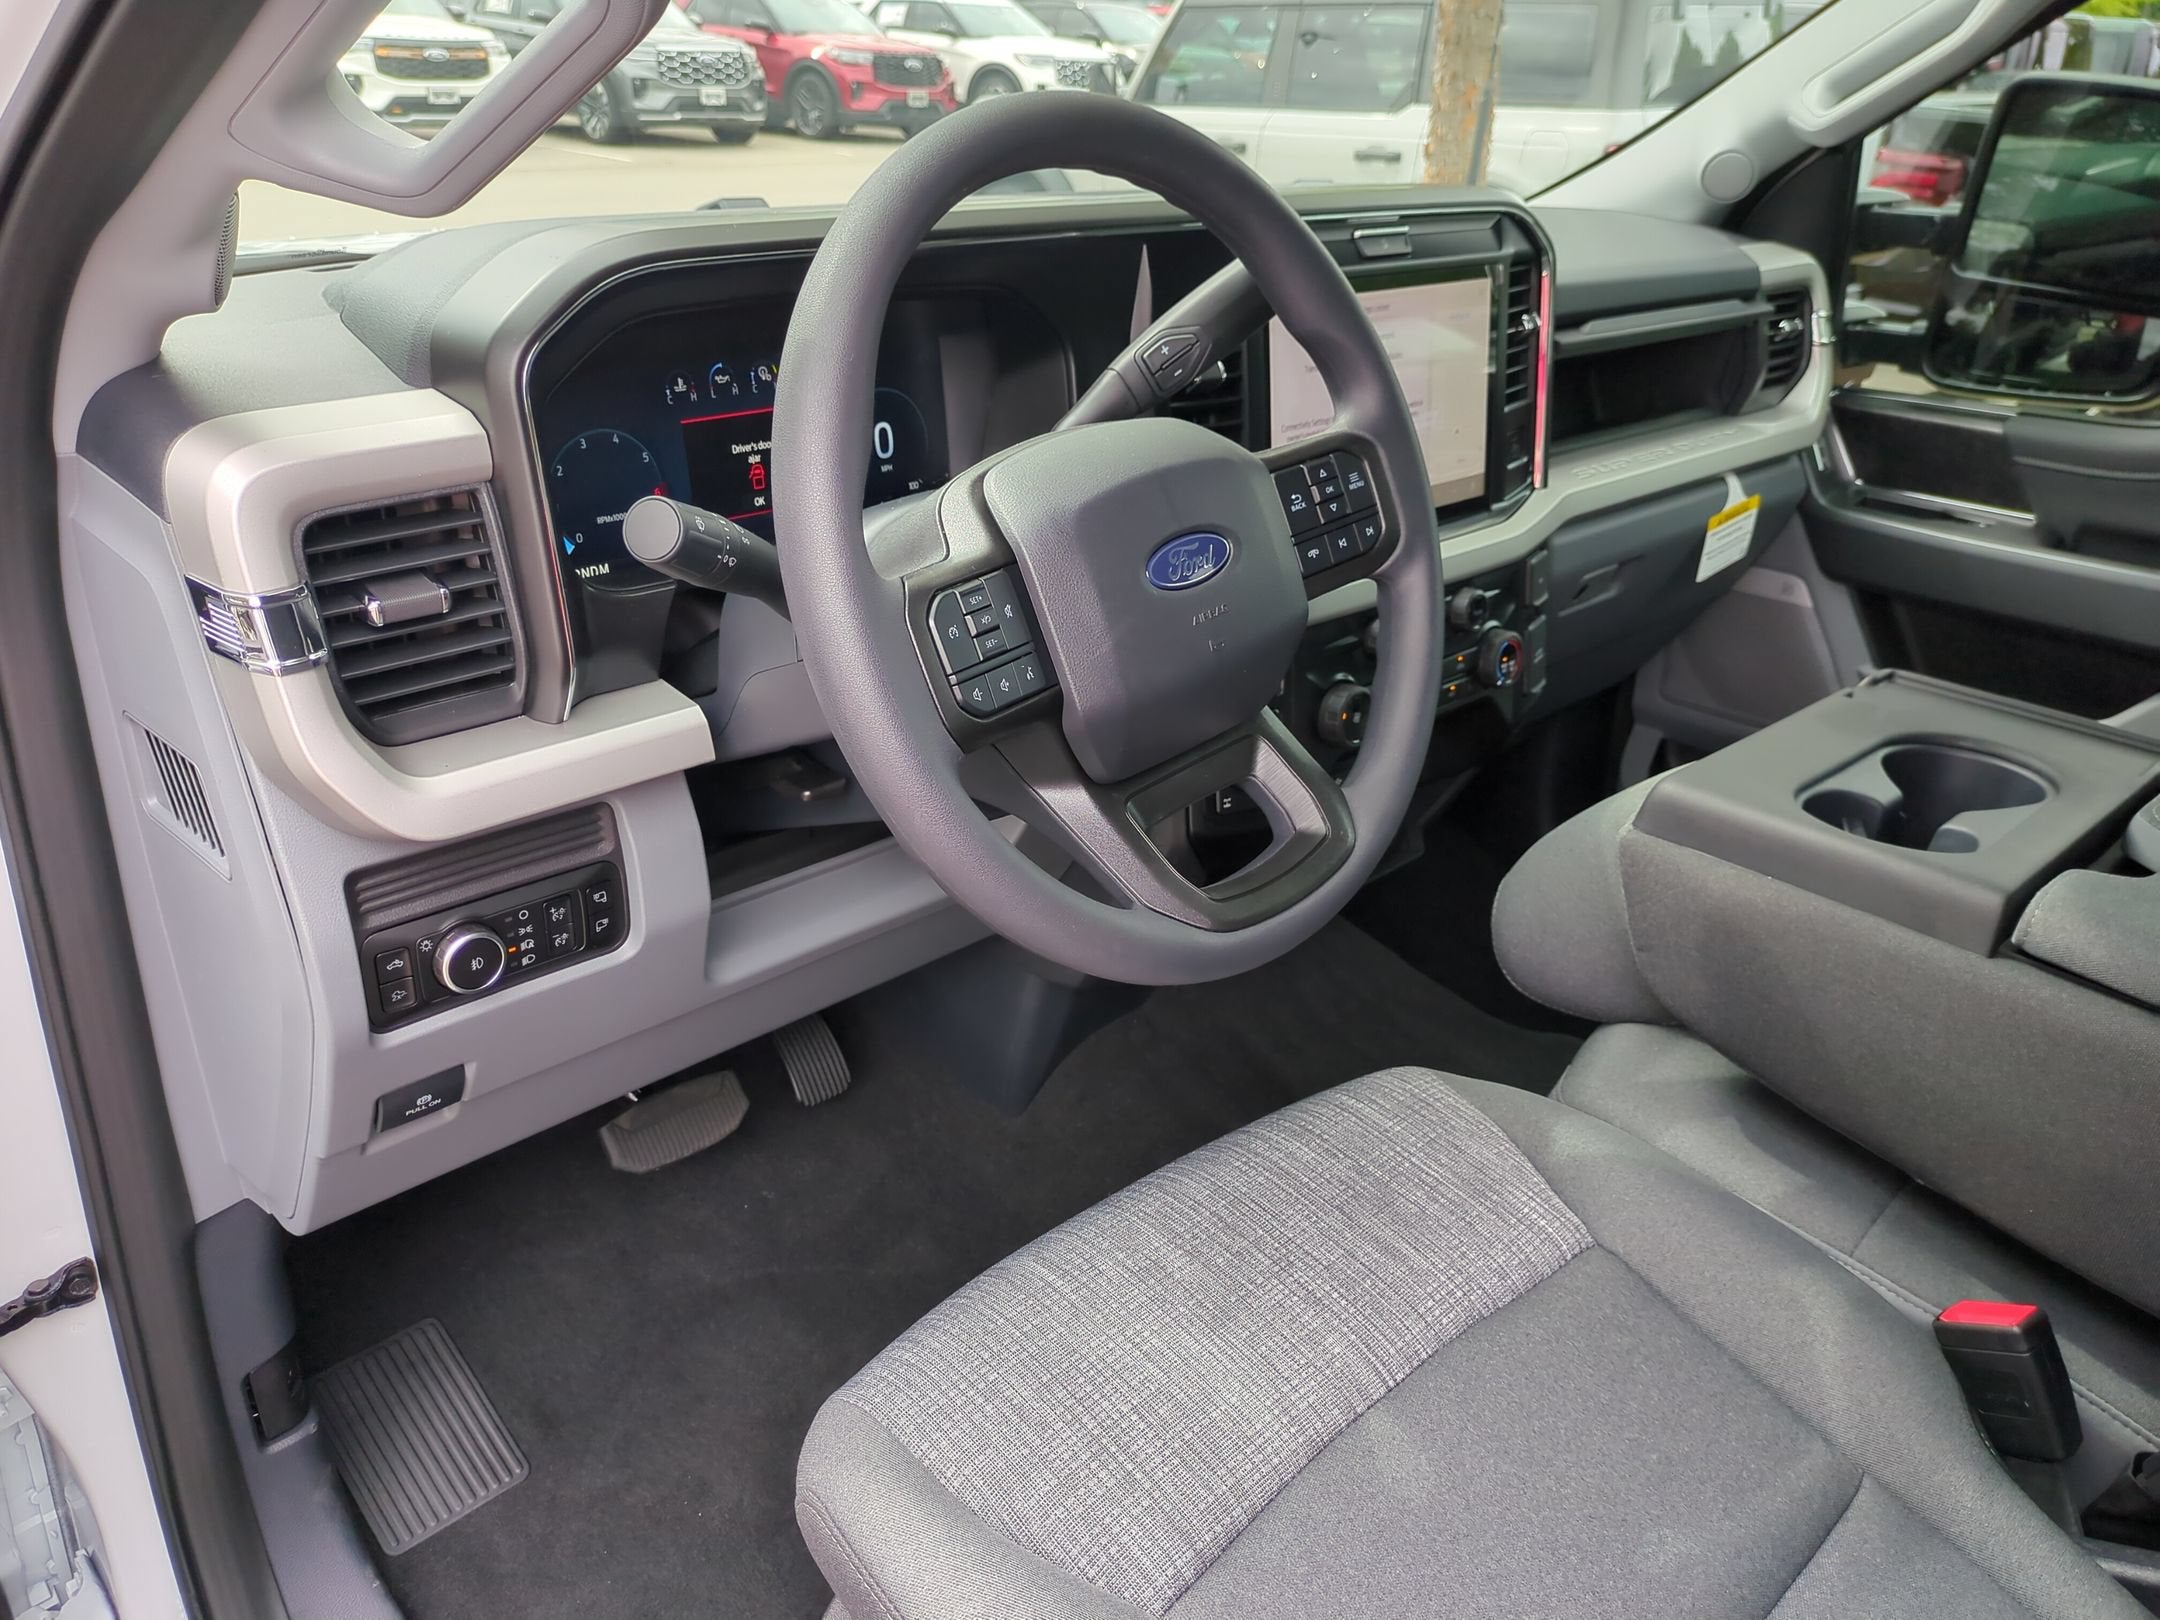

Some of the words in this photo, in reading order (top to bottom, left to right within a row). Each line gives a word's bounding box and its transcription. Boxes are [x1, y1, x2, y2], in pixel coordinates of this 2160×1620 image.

[667, 395, 674, 405] C
[580, 438, 587, 449] 3
[612, 433, 620, 445] 4
[874, 421, 894, 459] 0
[731, 442, 757, 454] Driver's
[642, 452, 650, 463] 5
[748, 454, 761, 464] ajar
[556, 465, 564, 477] 2
[1325, 486, 1335, 494] OK
[1348, 480, 1364, 491] MENU
[753, 496, 765, 506] OK
[1290, 502, 1307, 513] BACK
[575, 532, 584, 544] 0
[1168, 541, 1217, 581] Ford
[405, 1105, 428, 1116] PULL
[428, 1098, 442, 1107] ON
